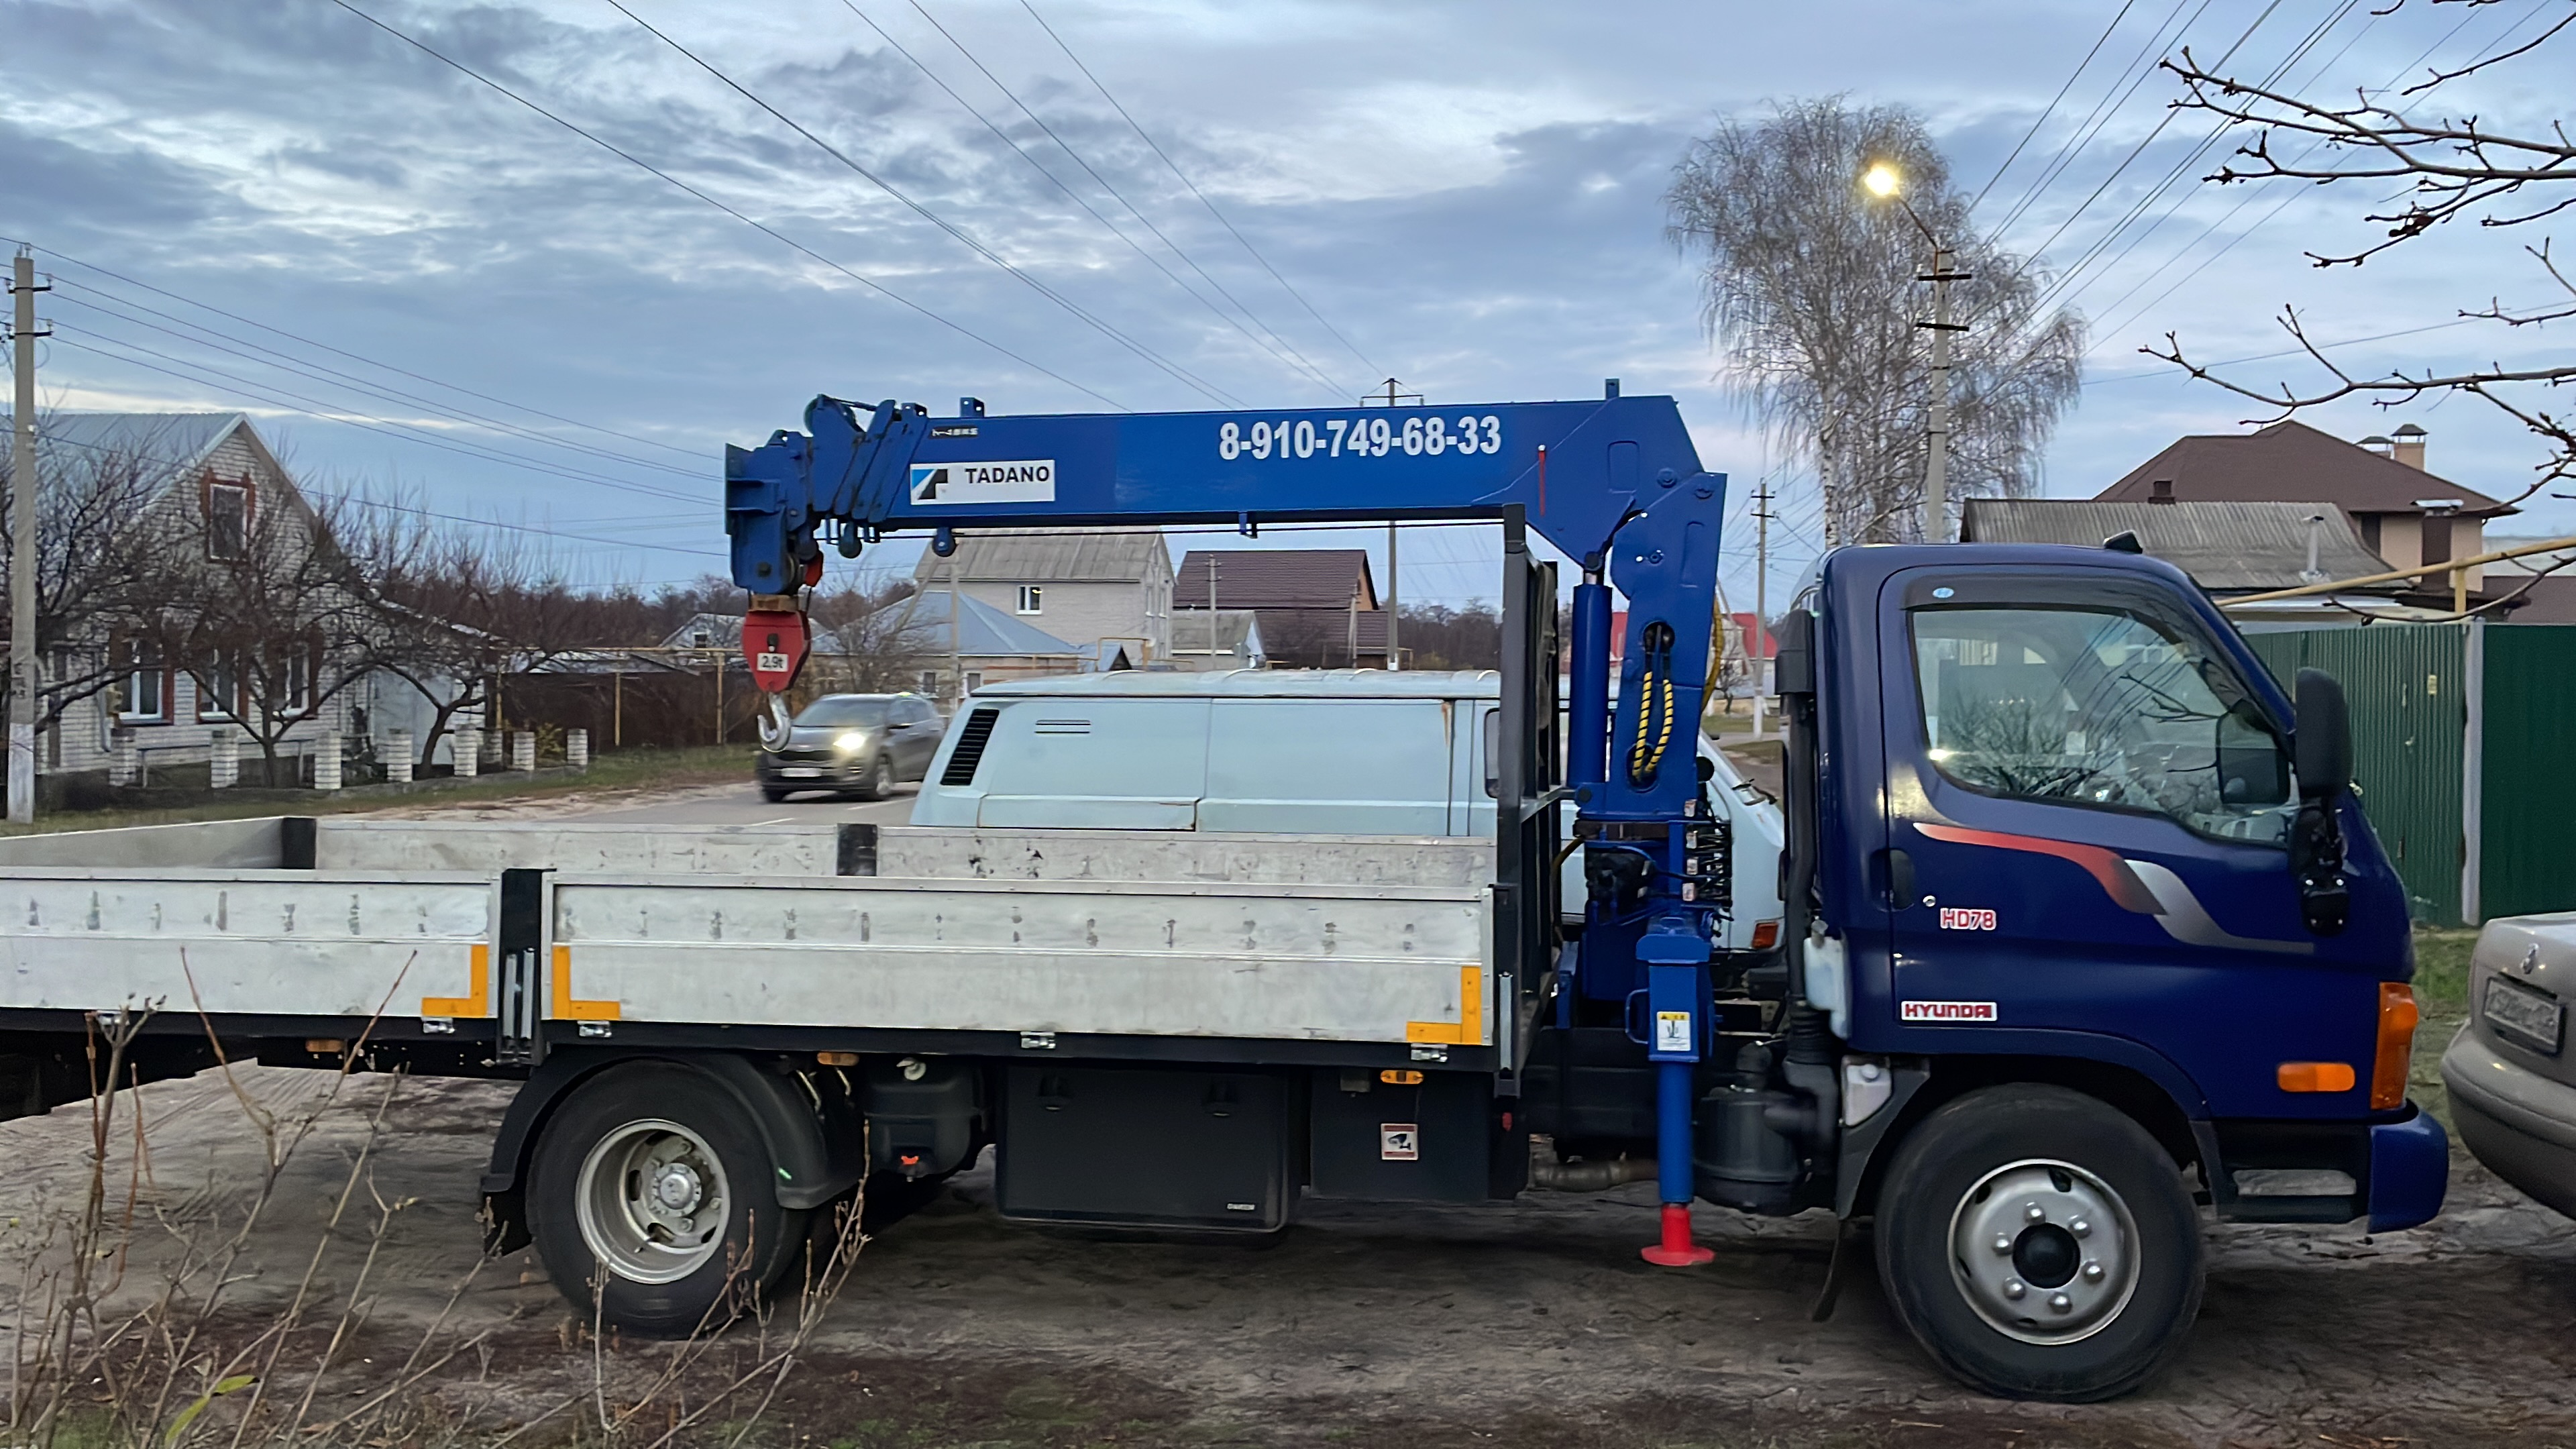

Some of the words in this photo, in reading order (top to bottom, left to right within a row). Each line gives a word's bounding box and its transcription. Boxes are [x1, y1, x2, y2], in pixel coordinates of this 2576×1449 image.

[1219, 415, 1501, 460] 8-910-749-68-33
[965, 466, 1050, 483] TADANO
[1941, 908, 1996, 930] HD78
[1904, 1004, 1992, 1019] HYUNDAI
